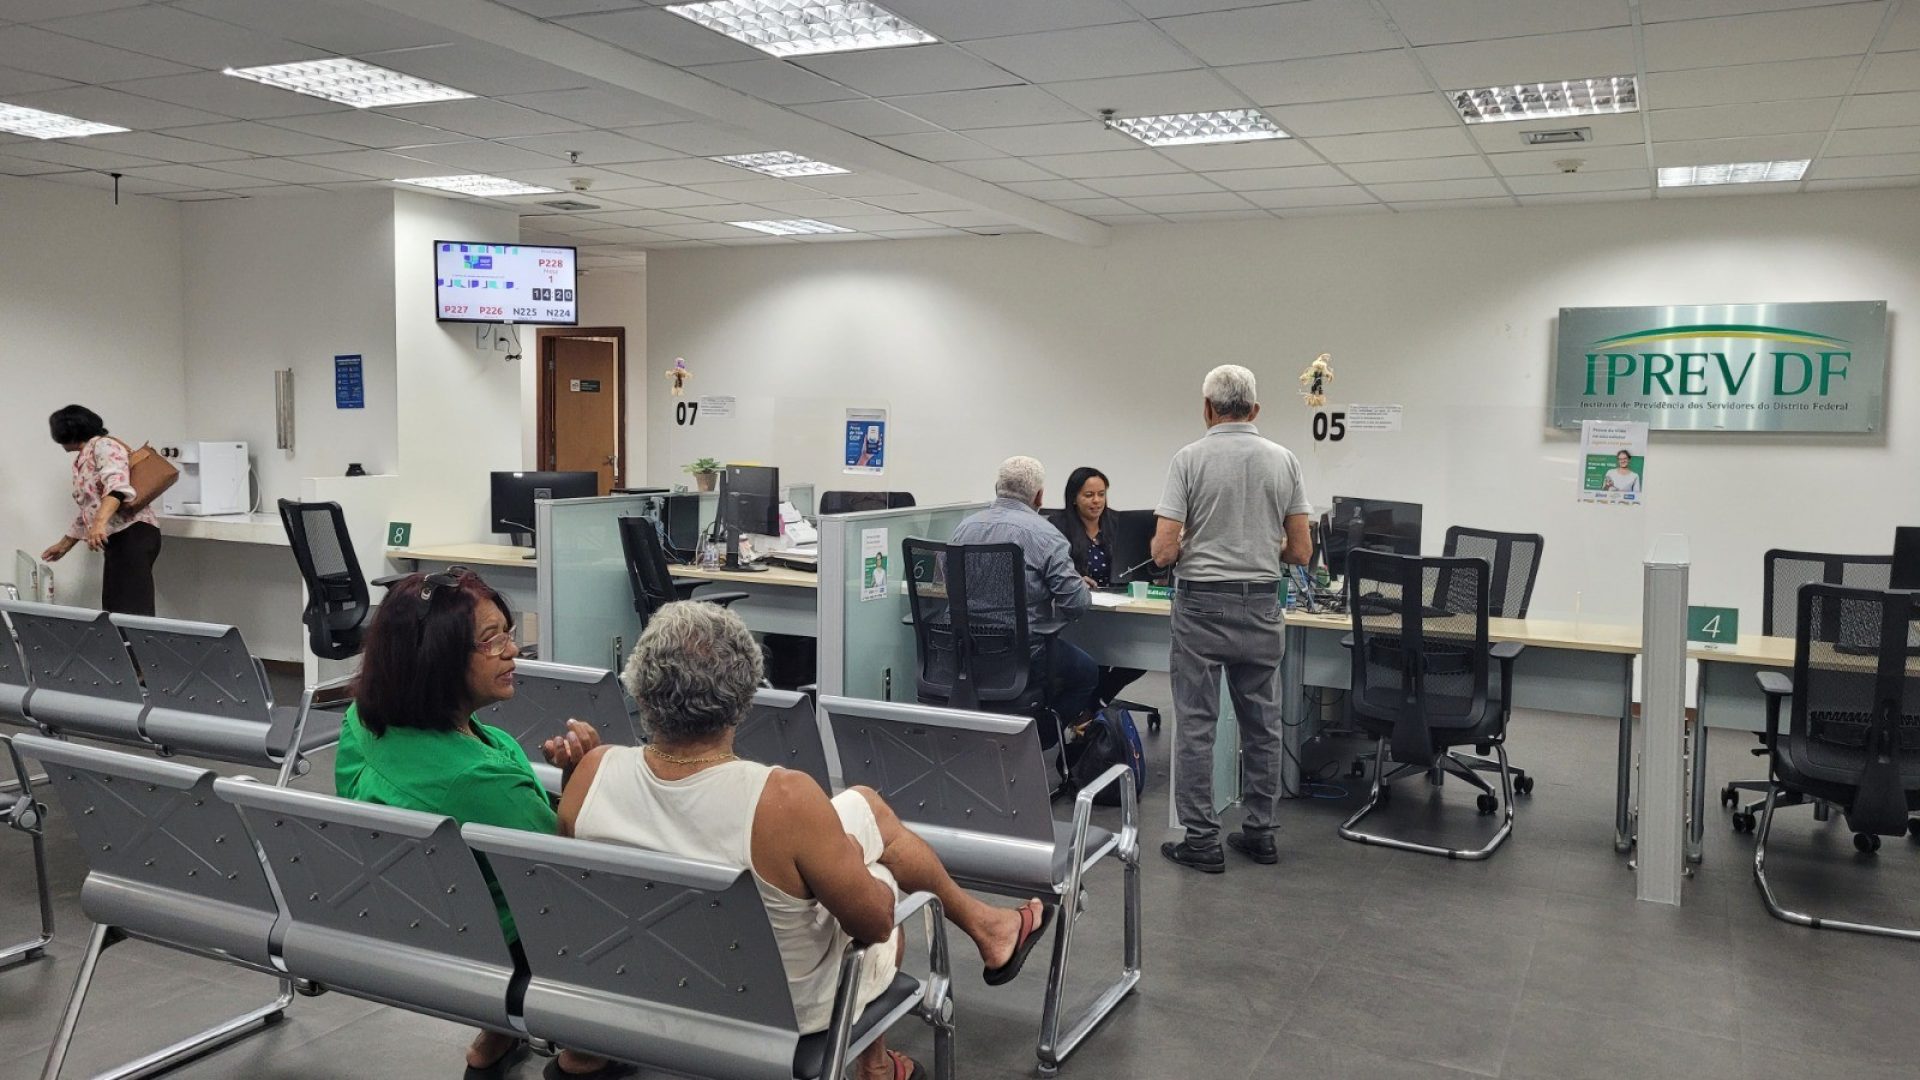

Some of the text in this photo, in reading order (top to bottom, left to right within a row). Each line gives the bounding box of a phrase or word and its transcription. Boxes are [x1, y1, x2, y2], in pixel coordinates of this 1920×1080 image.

[538, 258, 564, 268] P228
[444, 305, 571, 317] P227 P226 N225 N224
[1582, 352, 1851, 396] IPREV DF
[676, 401, 698, 425] 07
[1580, 401, 1849, 411] Instituto de Previdência dos Servidores do Distrito Federal
[1312, 411, 1346, 441] 05
[394, 527, 404, 544] 8
[913, 559, 925, 579] 6
[1701, 614, 1721, 639] 4
